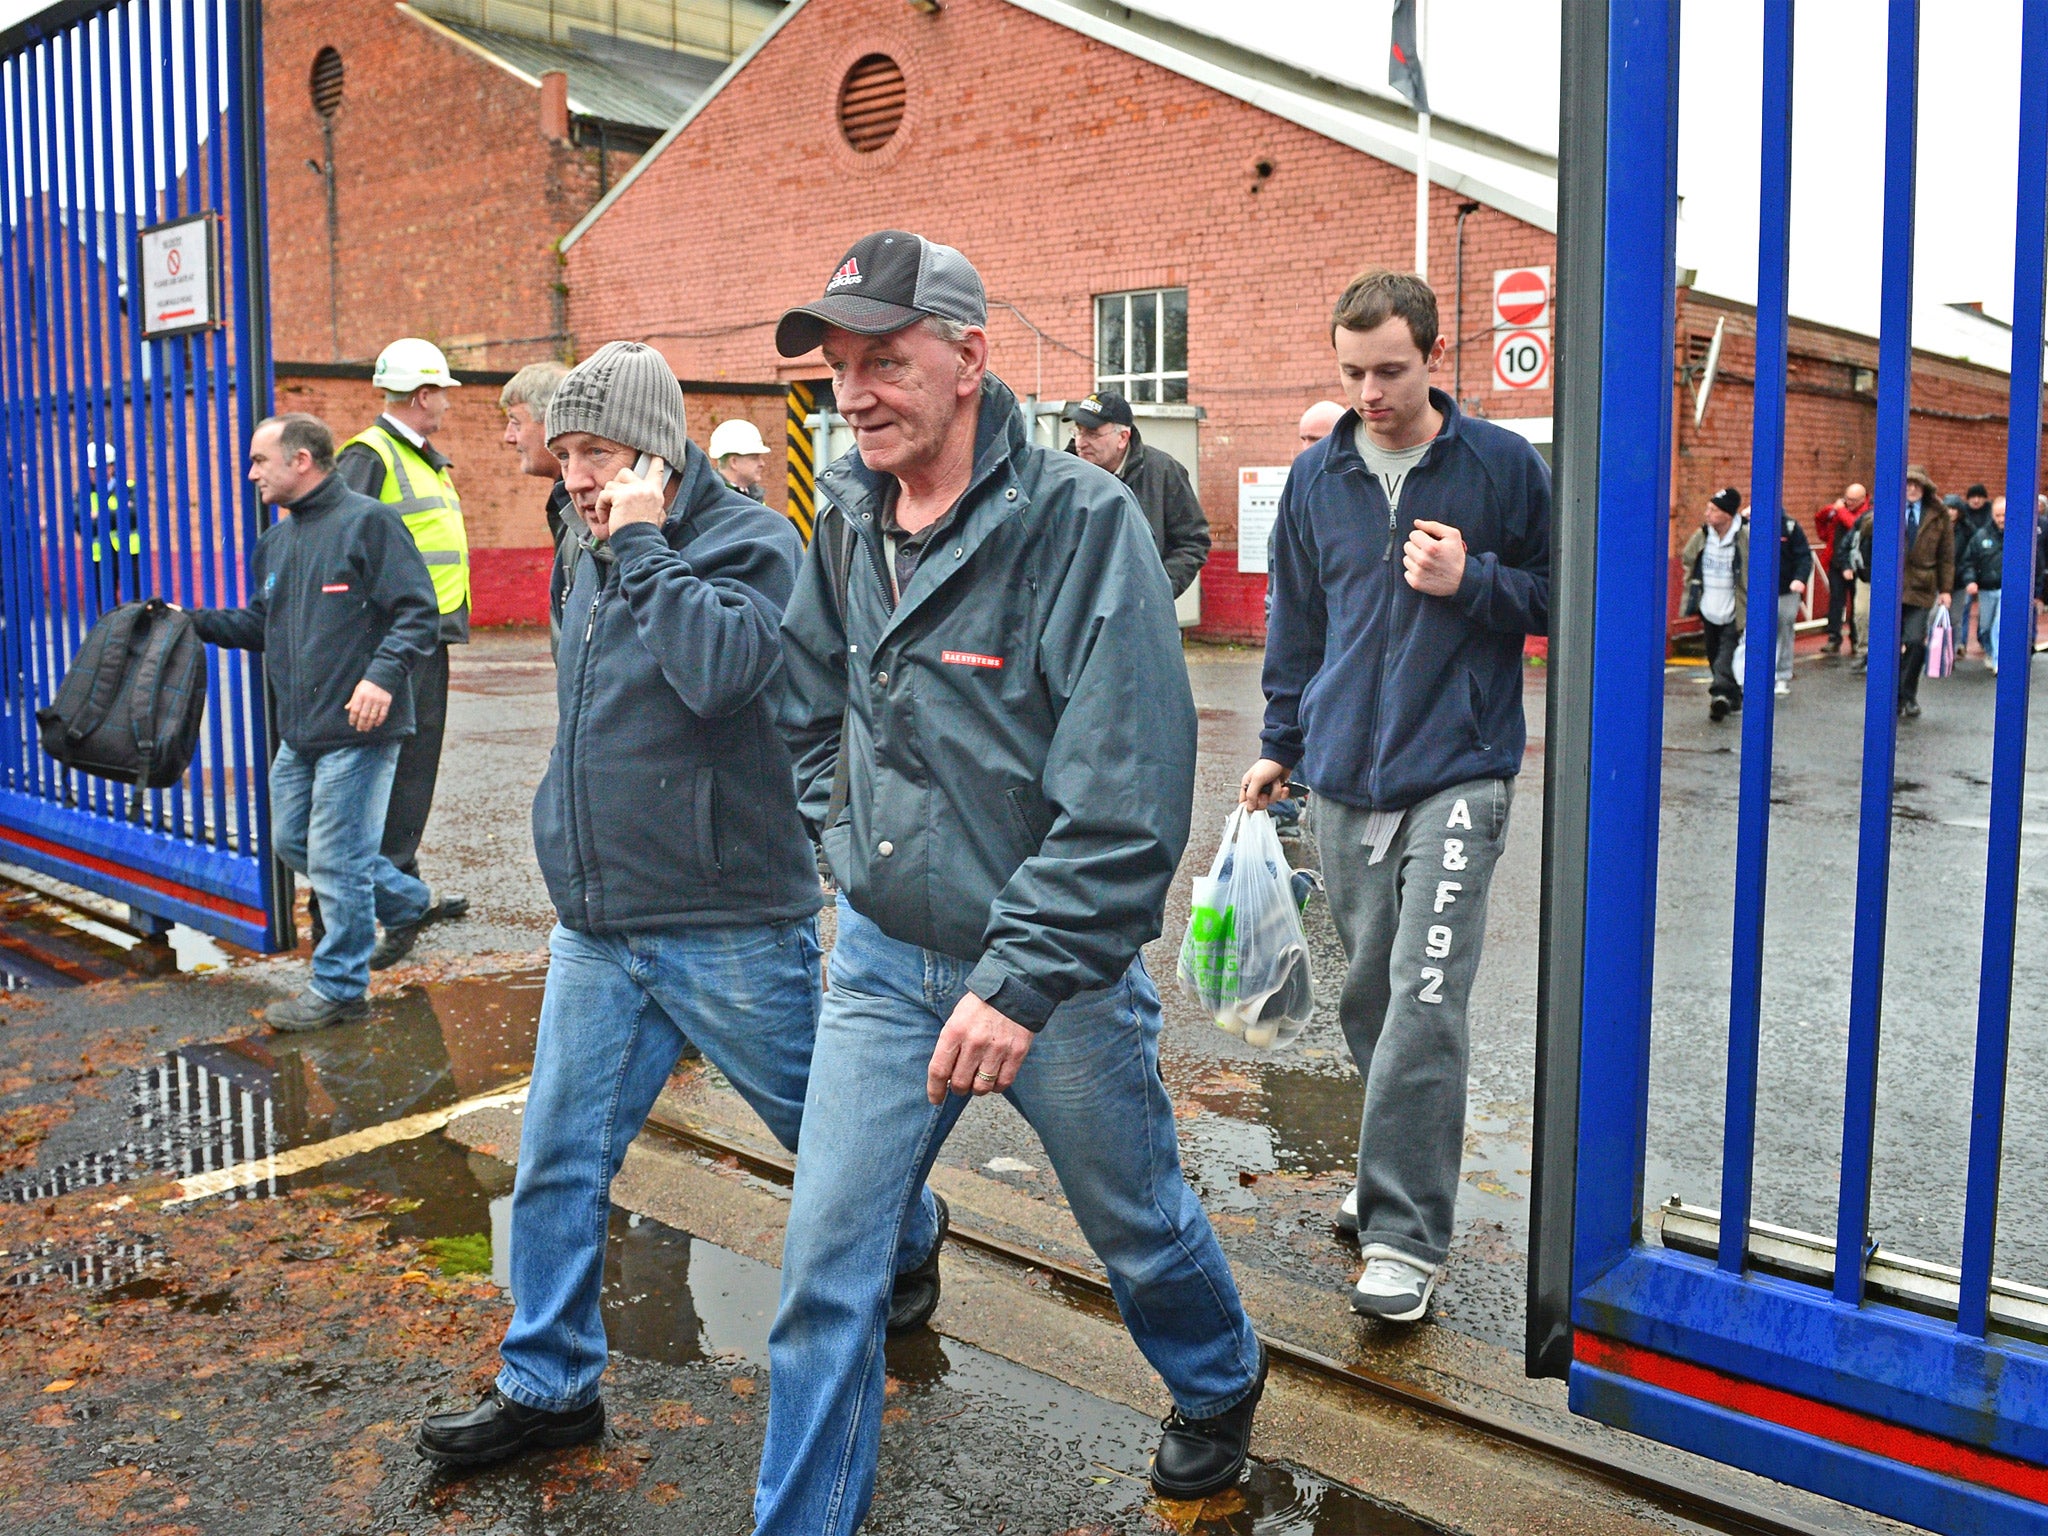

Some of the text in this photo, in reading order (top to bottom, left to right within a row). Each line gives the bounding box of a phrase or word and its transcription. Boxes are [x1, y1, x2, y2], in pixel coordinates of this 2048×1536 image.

[1505, 346, 1537, 373] 10
[944, 653, 1000, 666] BAE SYSTEMS
